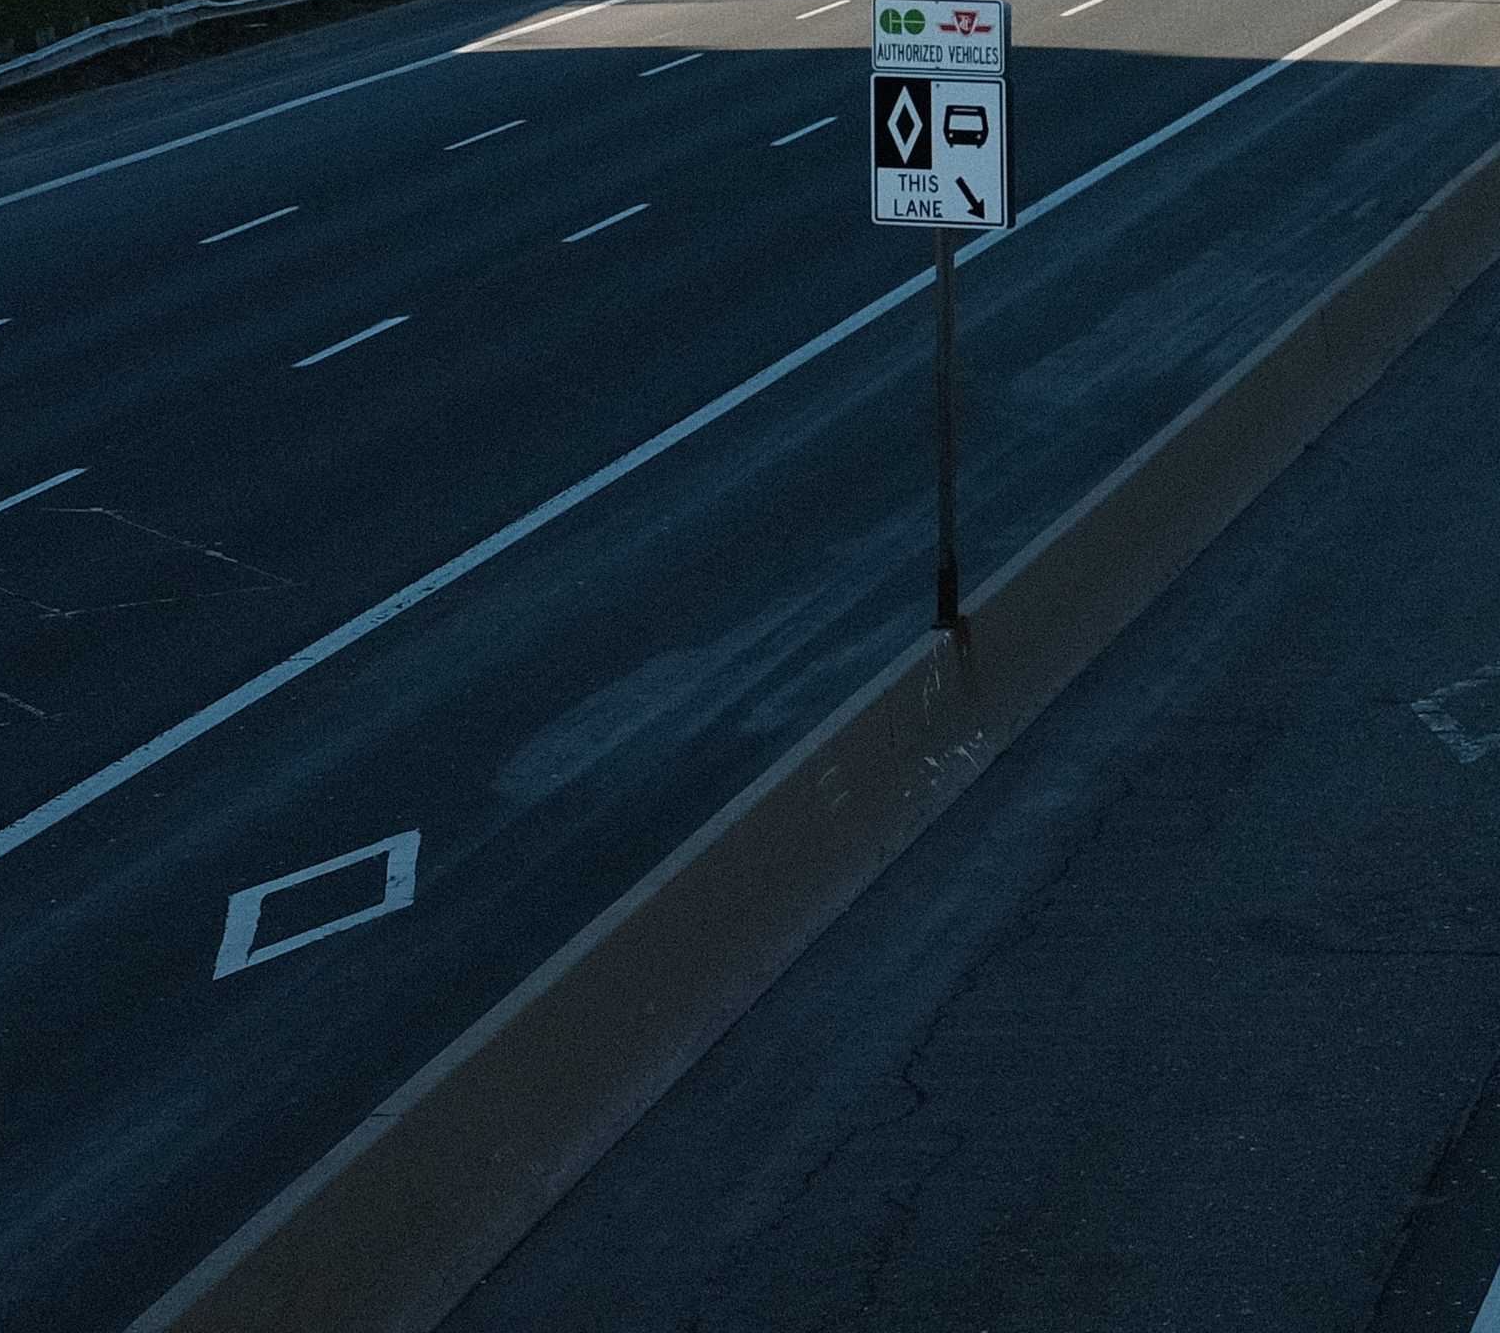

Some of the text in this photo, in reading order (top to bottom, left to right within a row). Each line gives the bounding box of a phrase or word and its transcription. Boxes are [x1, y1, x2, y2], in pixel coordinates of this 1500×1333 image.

[877, 43, 999, 65] AUTHORIZED VEHICLES
[898, 174, 939, 193] THIS
[894, 198, 943, 218] LANE
